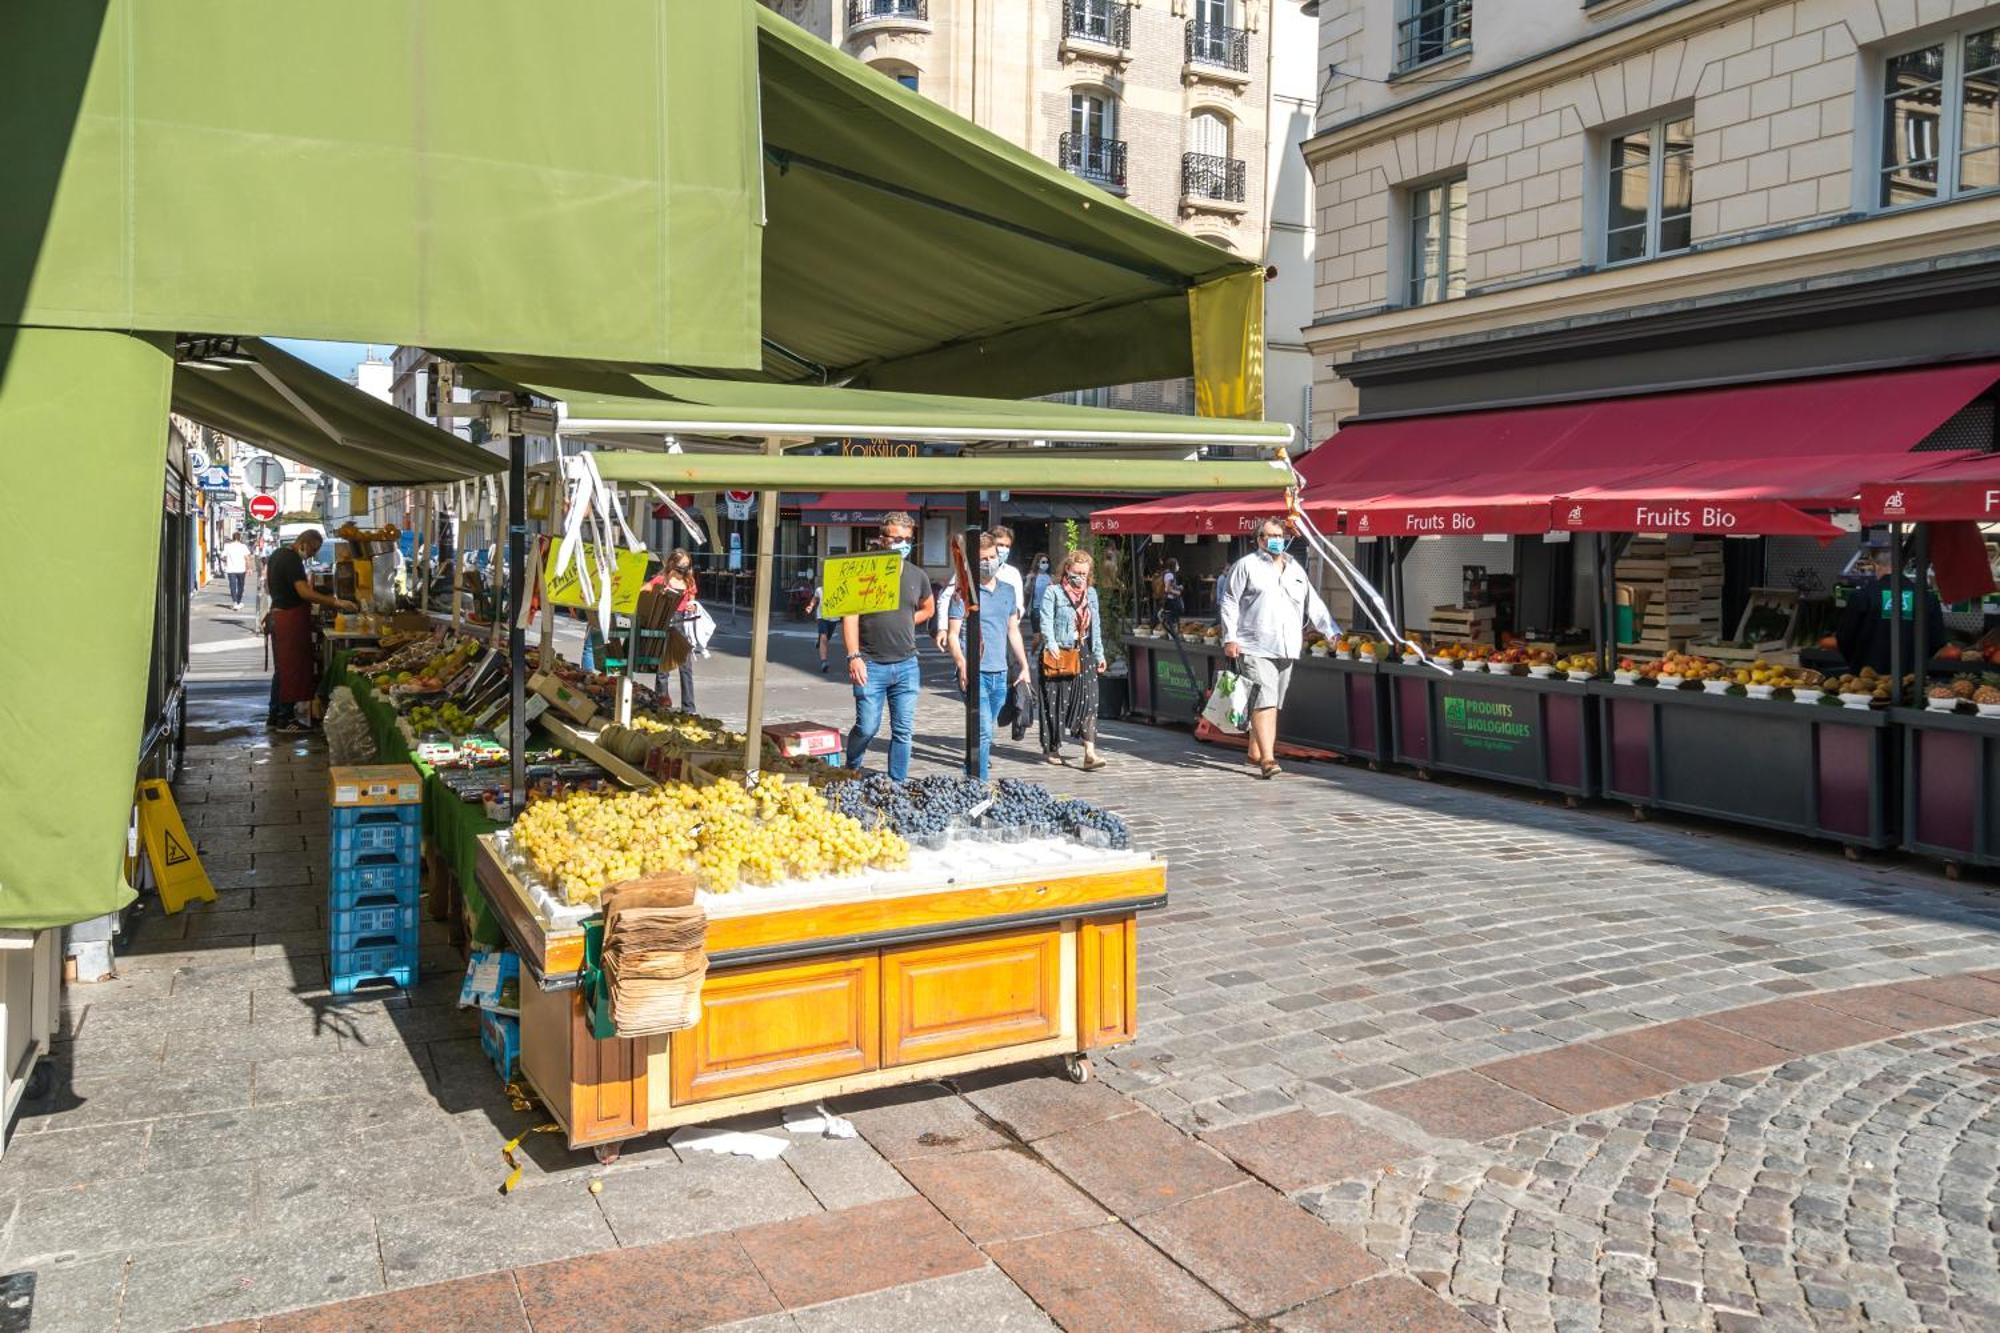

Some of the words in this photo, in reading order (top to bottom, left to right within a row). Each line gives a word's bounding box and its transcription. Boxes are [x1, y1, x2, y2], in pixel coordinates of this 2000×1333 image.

[1239, 516, 1257, 530] Frui
[1406, 513, 1445, 530] Fruits
[1452, 513, 1475, 529] Bio
[1636, 507, 1691, 526] Fruits
[1702, 507, 1736, 527] Bio
[841, 559, 877, 577] RAISIN
[1466, 700, 1513, 717] PRODUITS
[1467, 718, 1530, 736] BIOLOGIQUES
